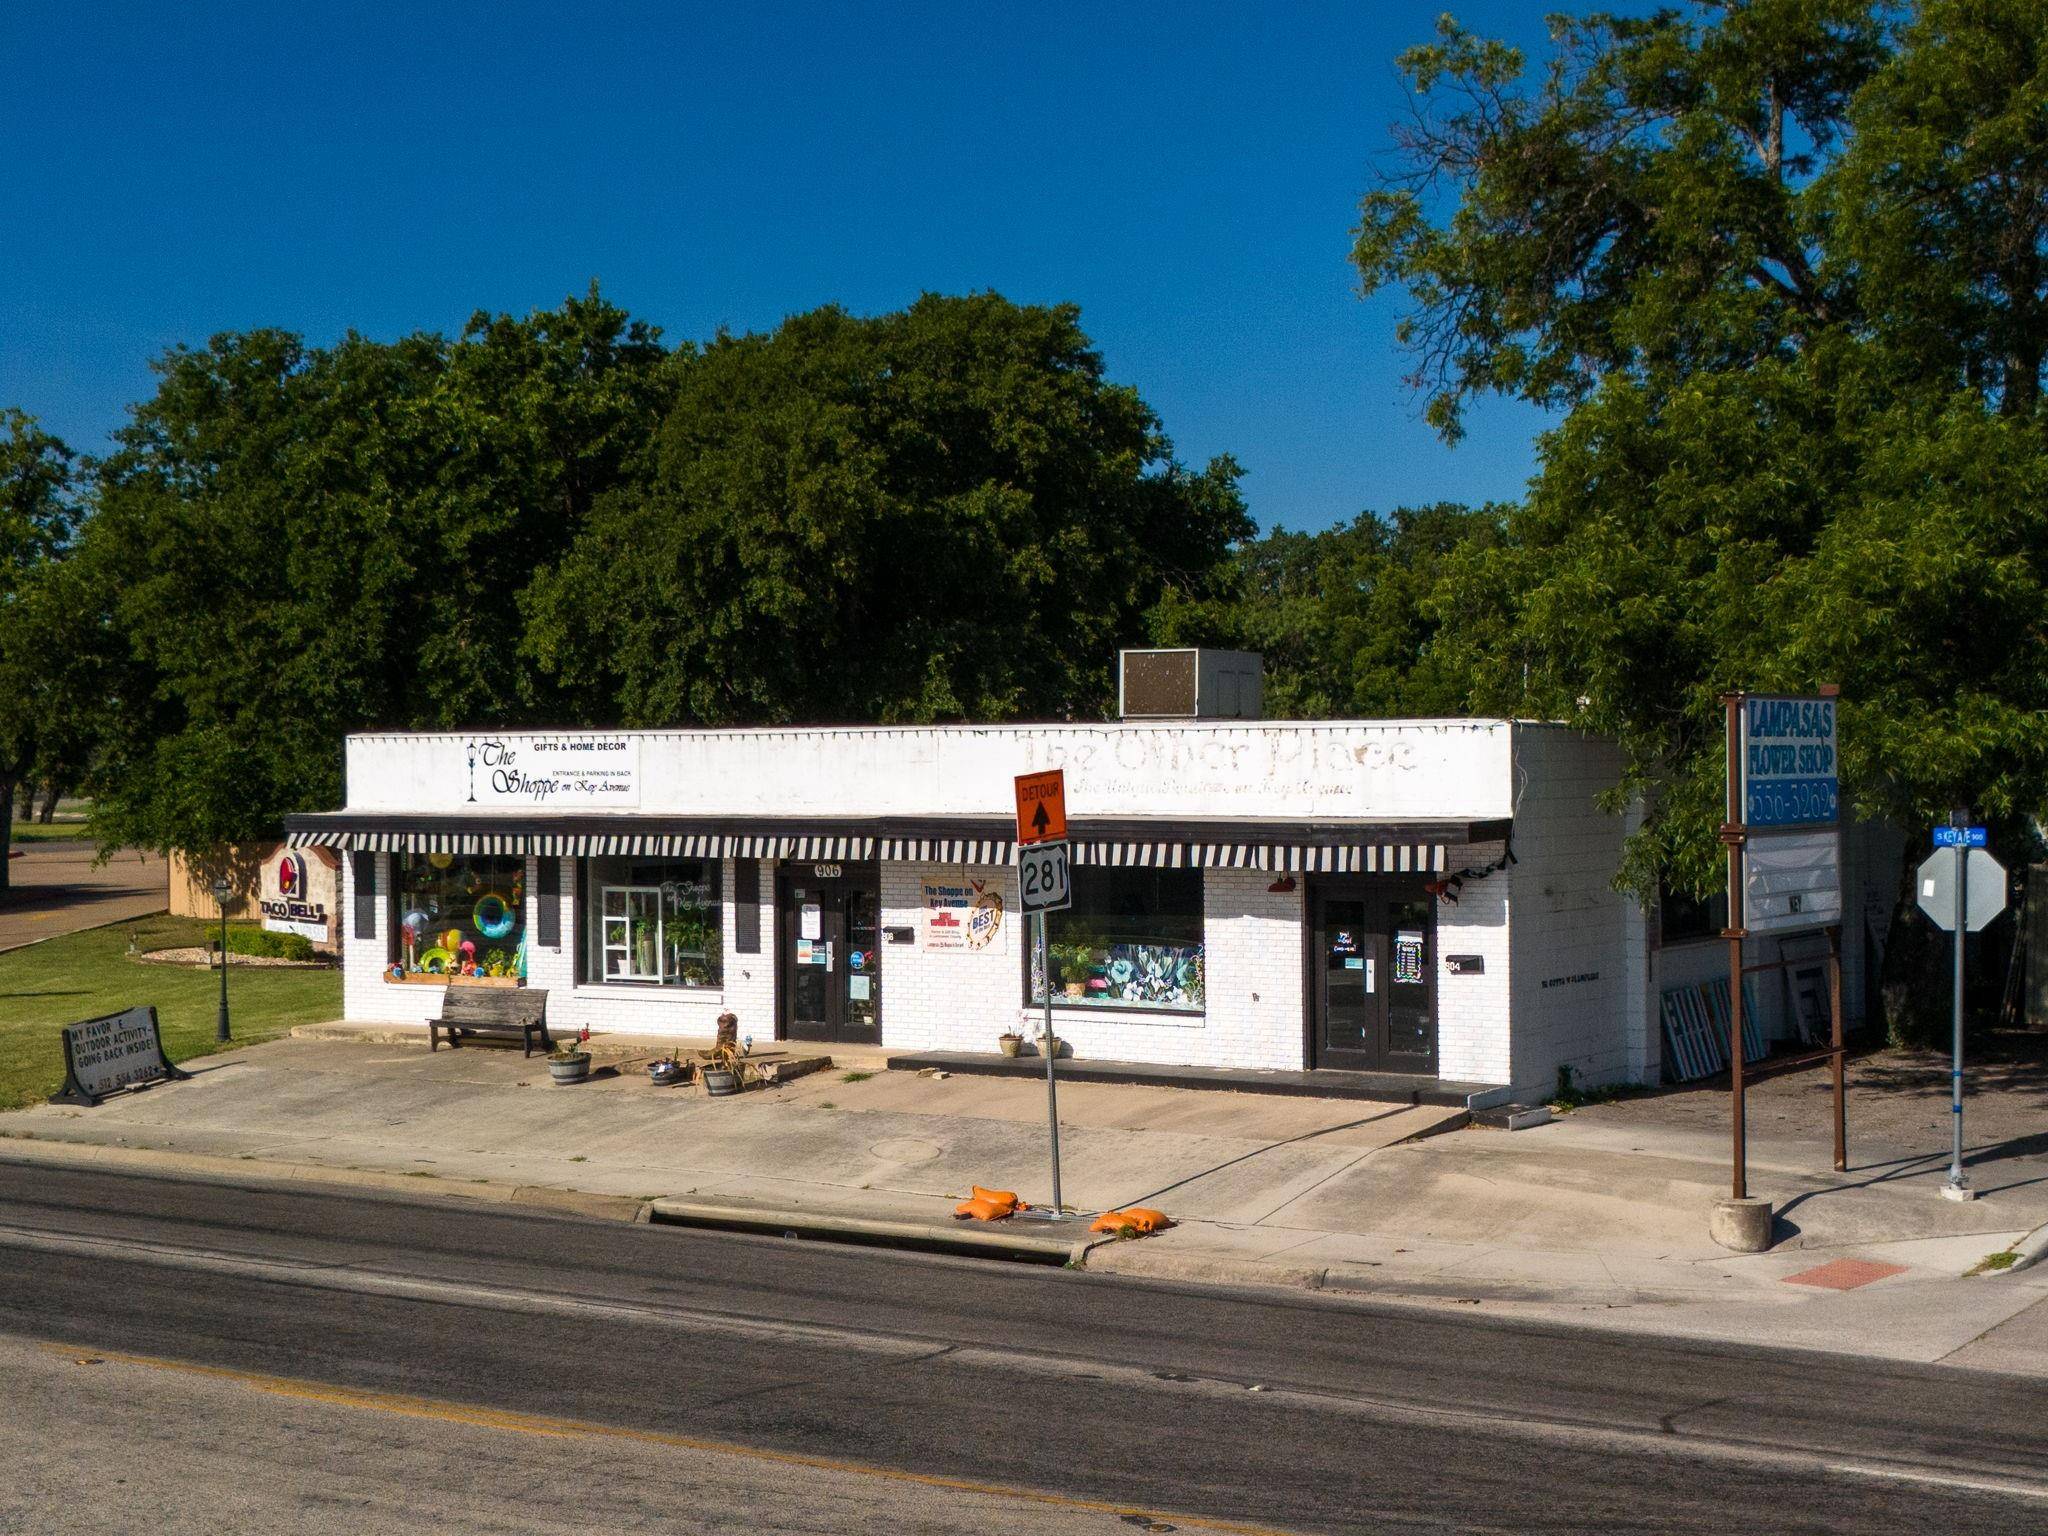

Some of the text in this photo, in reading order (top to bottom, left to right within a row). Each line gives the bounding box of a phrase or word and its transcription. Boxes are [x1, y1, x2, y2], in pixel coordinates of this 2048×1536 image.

[1749, 700, 1832, 738] LAMPASAS
[479, 742, 516, 766] The
[534, 742, 626, 752] GIFTS & HOME DECOR
[1749, 744, 1833, 775] FLOWER SHOP
[492, 769, 631, 801] Shoppe on Key Avenue
[1022, 782, 1059, 802] DETOUR
[1754, 782, 1830, 821] 556-3262
[817, 865, 839, 877] 906
[1025, 857, 1064, 896] 281
[925, 886, 974, 897] The Shoppe on
[260, 901, 318, 919] TACO BELL
[930, 898, 968, 910] Key Avenue
[972, 910, 994, 929] BEST
[72, 1029, 83, 1041] MY
[86, 1022, 112, 1037] FAVOR
[75, 1036, 112, 1054] OUTDOOR
[79, 1052, 102, 1068] GOING
[104, 1047, 124, 1061] BACK
